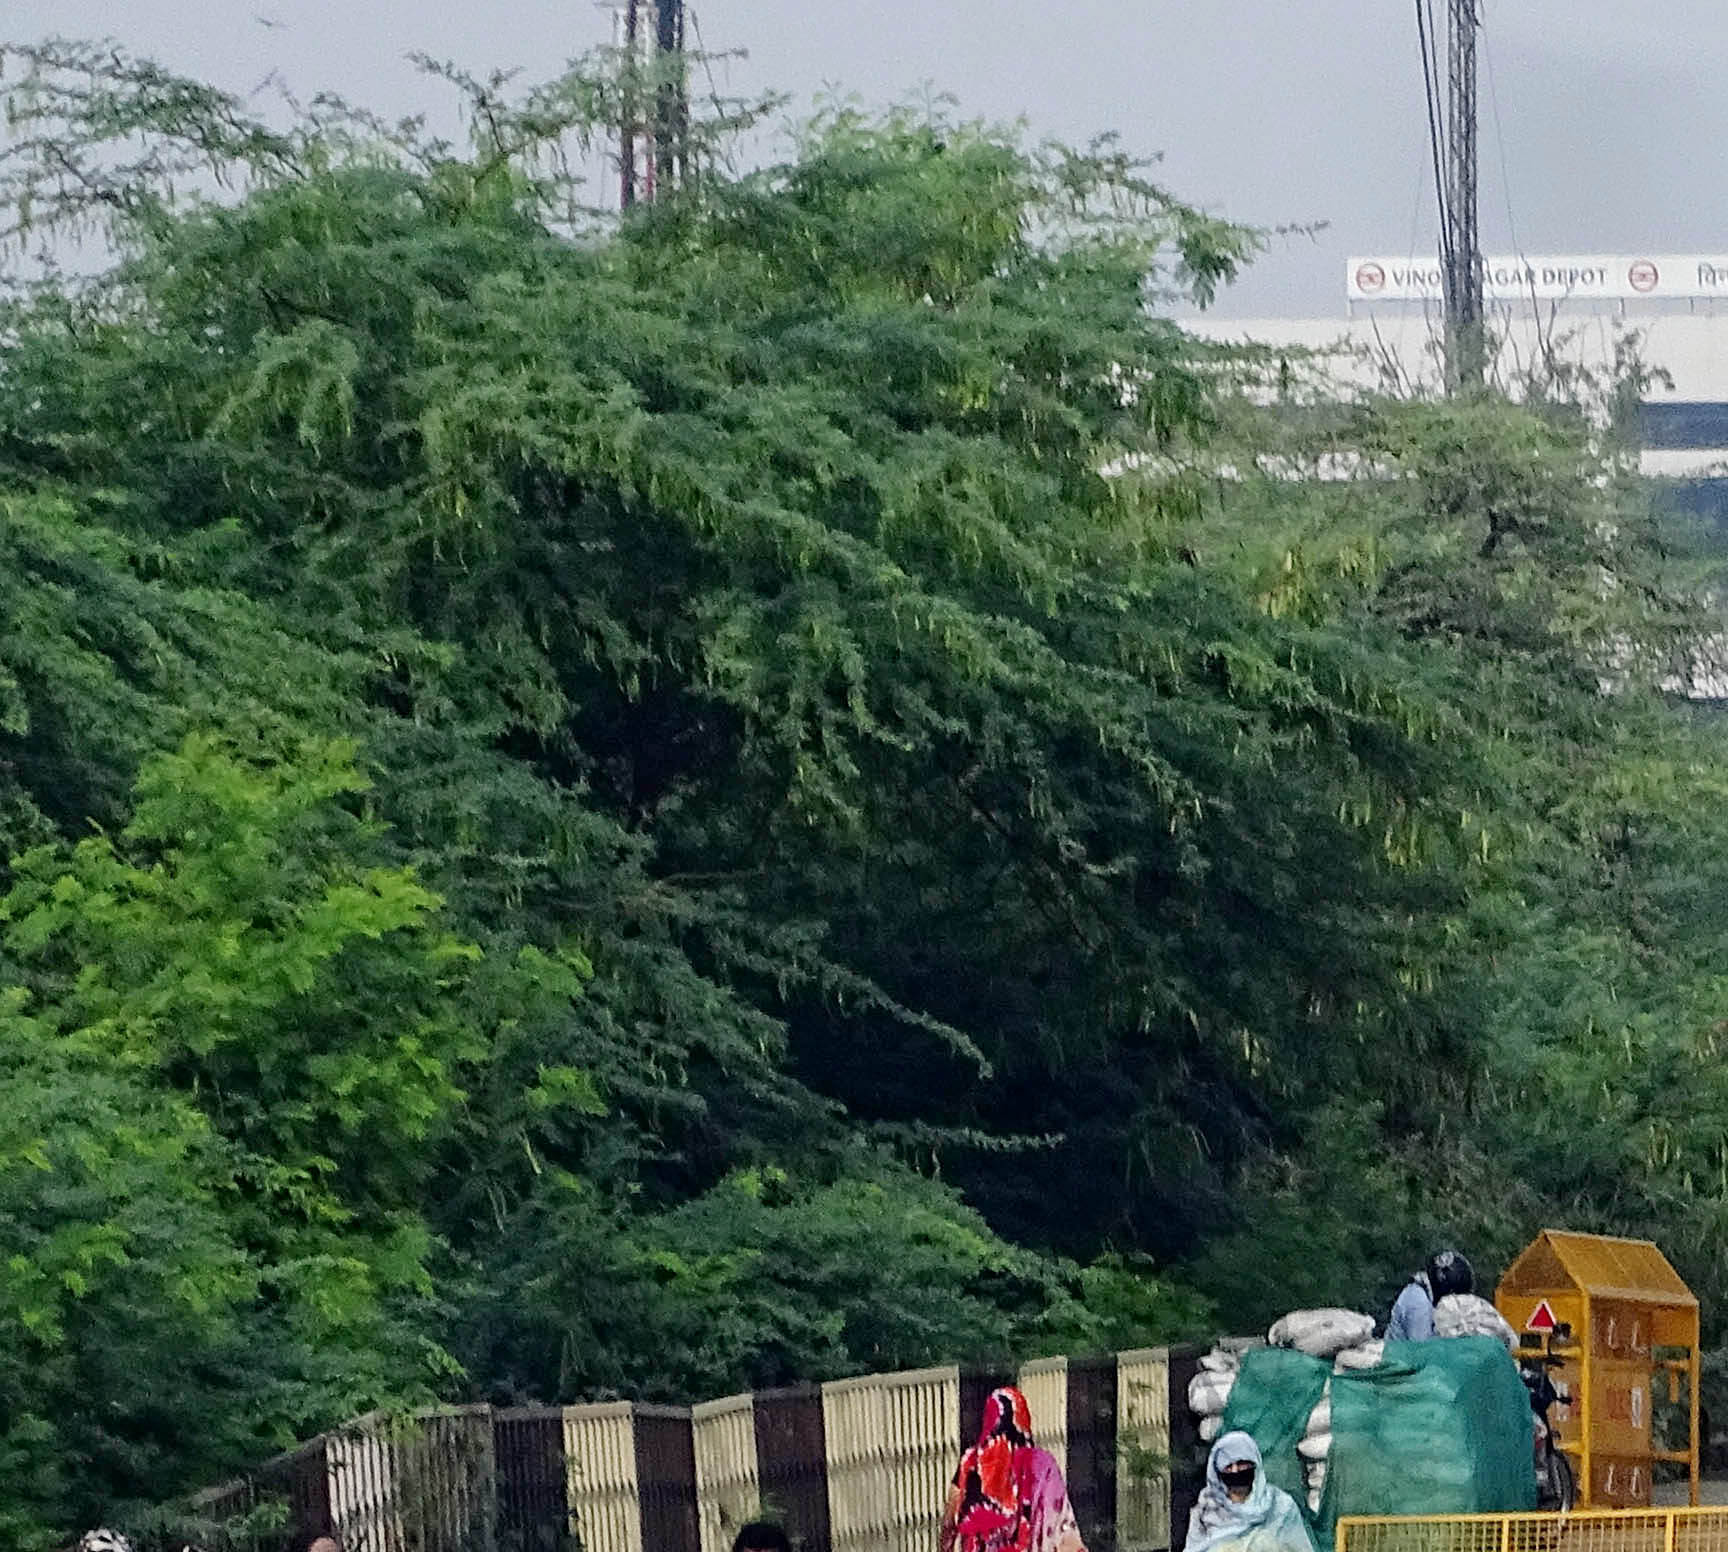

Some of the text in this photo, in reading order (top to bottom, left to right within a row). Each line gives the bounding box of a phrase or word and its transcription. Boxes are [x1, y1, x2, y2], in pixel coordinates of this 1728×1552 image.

[1392, 267, 1608, 286] VINO AGAR DEPOT
